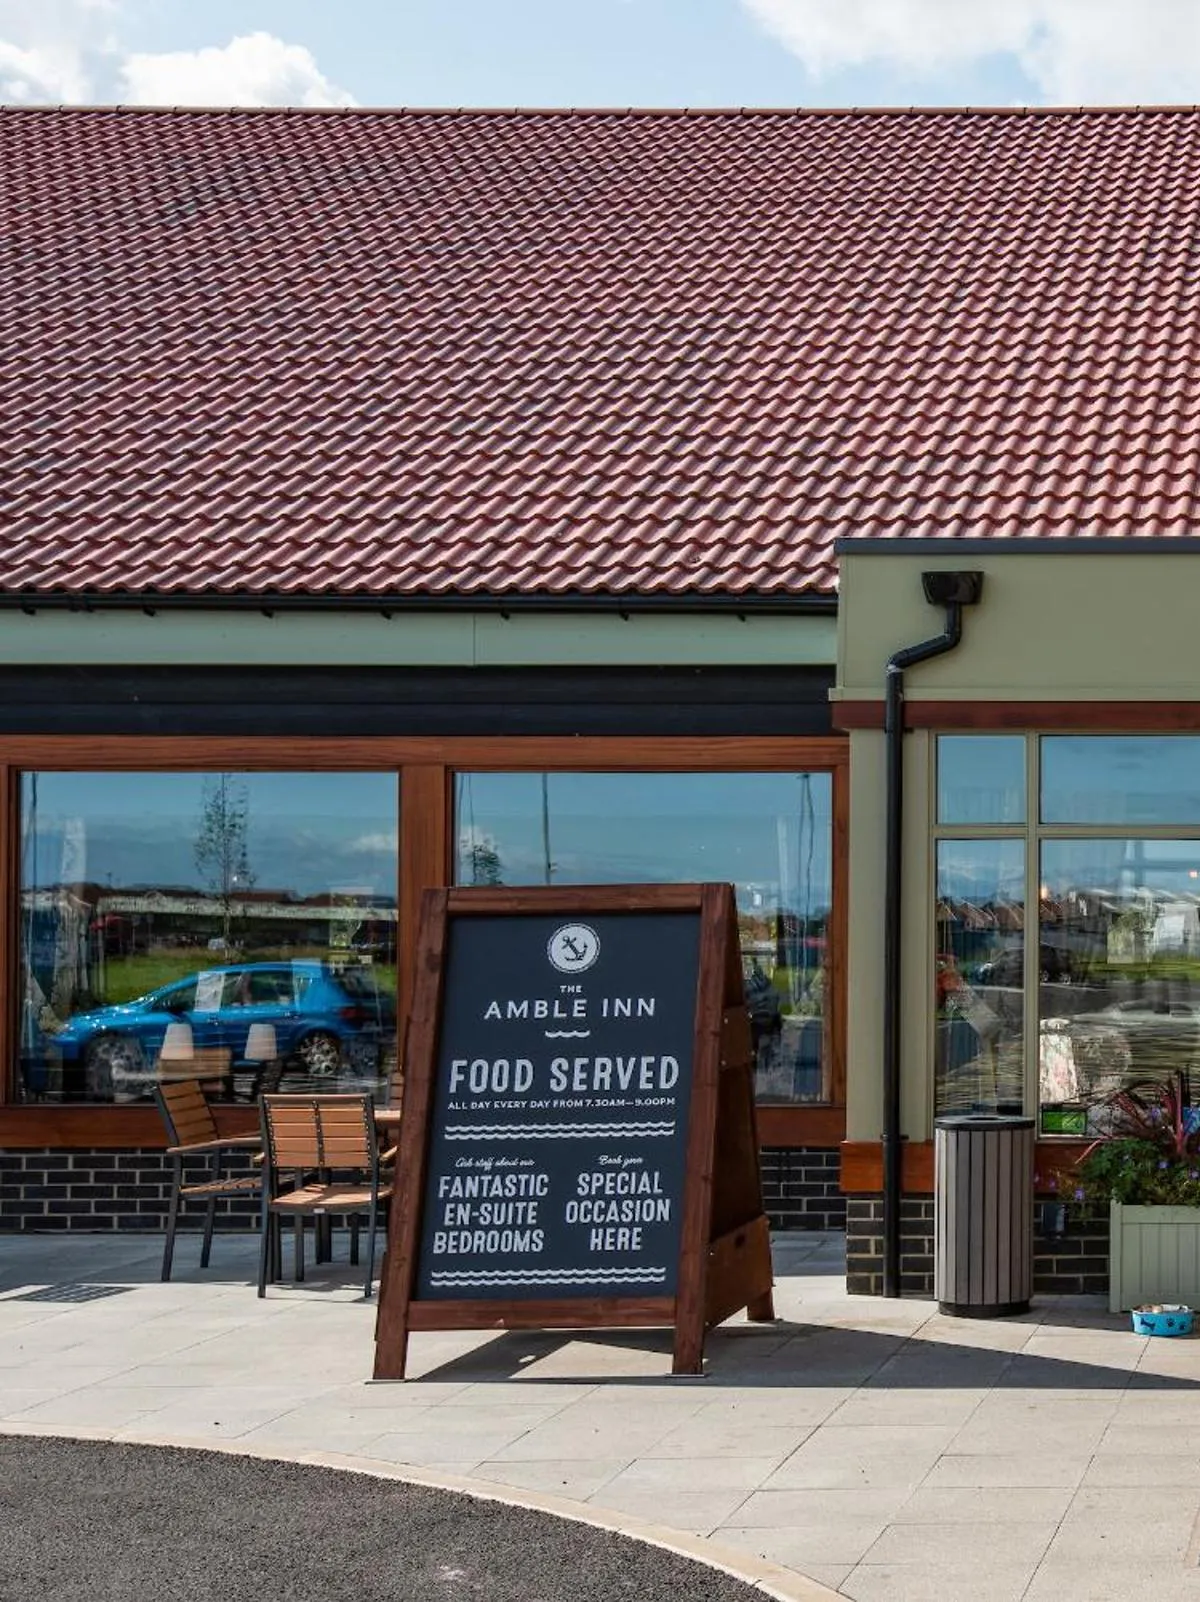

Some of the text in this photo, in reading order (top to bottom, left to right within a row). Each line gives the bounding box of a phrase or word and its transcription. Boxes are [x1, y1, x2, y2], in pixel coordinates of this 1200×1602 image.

[559, 984, 582, 993] THE
[484, 998, 655, 1019] AMBLE INN
[450, 1056, 678, 1093] FOOD SERVED
[447, 1101, 468, 1110] ALL
[470, 1100, 492, 1110] DAY
[493, 1100, 528, 1109] EVERY
[529, 1099, 551, 1109] DAY
[552, 1098, 584, 1109] FROM
[439, 1174, 548, 1198] FANTASTIC
[577, 1172, 662, 1195] SPECIAL
[444, 1202, 538, 1225] EN-SUITE
[566, 1199, 670, 1223] OCCASION
[433, 1229, 544, 1253] BEDROOMS
[590, 1227, 642, 1250] HERE
